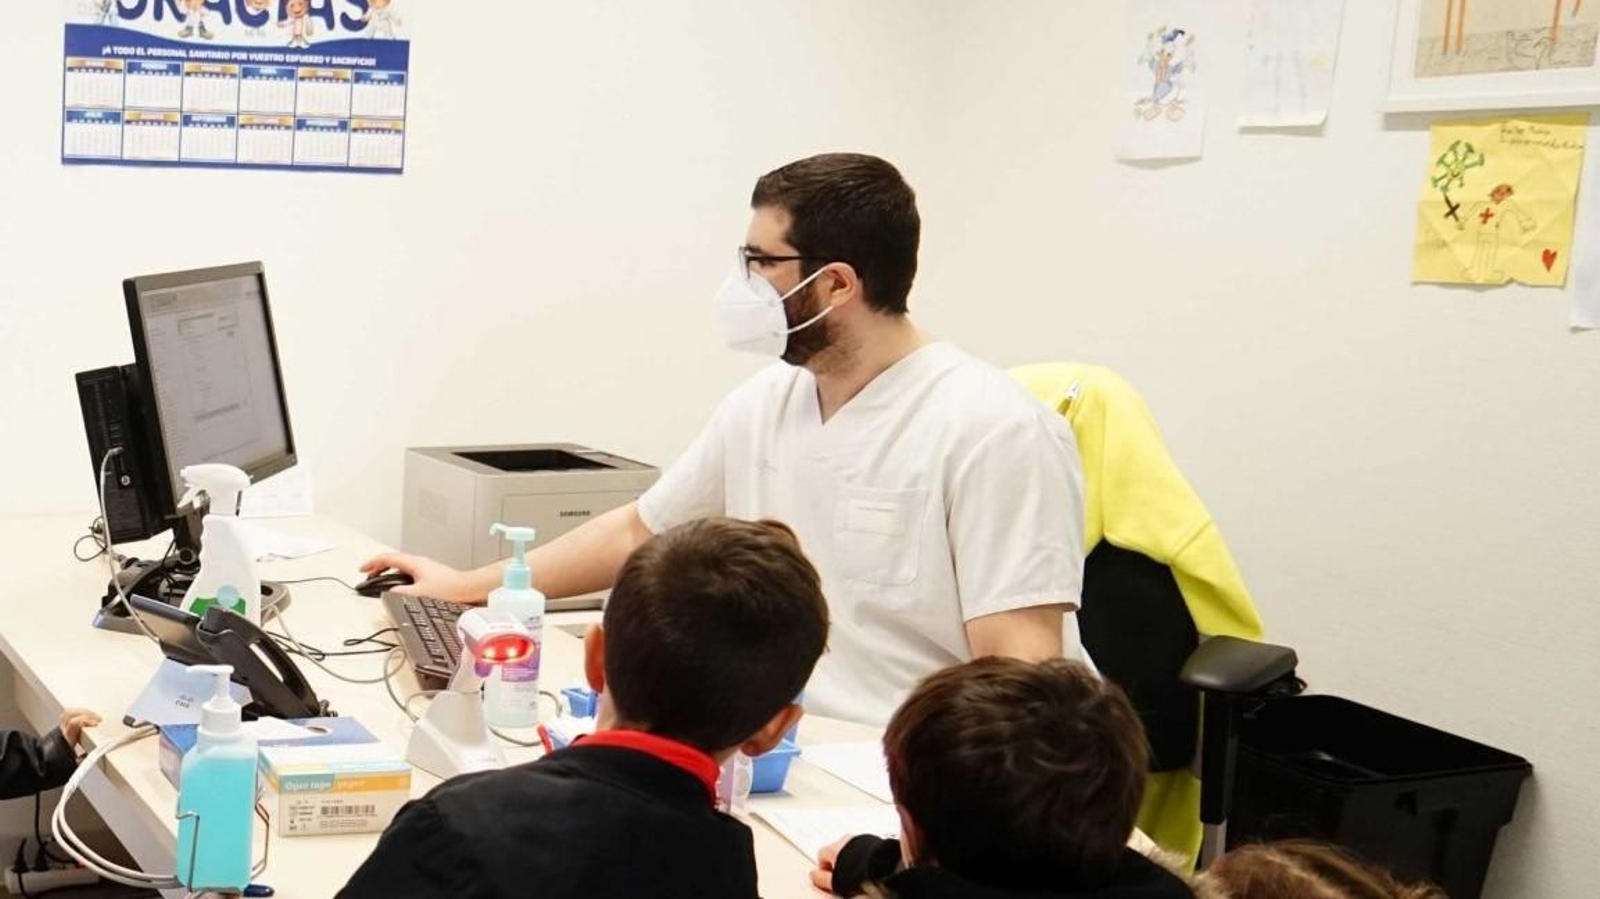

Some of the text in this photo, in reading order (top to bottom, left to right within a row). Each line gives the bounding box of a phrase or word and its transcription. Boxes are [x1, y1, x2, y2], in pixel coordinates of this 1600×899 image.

[113, 45, 135, 56] TODO
[136, 46, 146, 56] EL
[147, 47, 187, 58] PERSONAL
[188, 49, 231, 60] SANITARIO
[232, 51, 248, 61] POR
[249, 52, 285, 62] VUESTRO
[286, 53, 324, 64] ESFUERZO
[325, 55, 331, 64] Y
[332, 55, 376, 66] SACRIFICIO!
[559, 509, 591, 518] SAMSUNG
